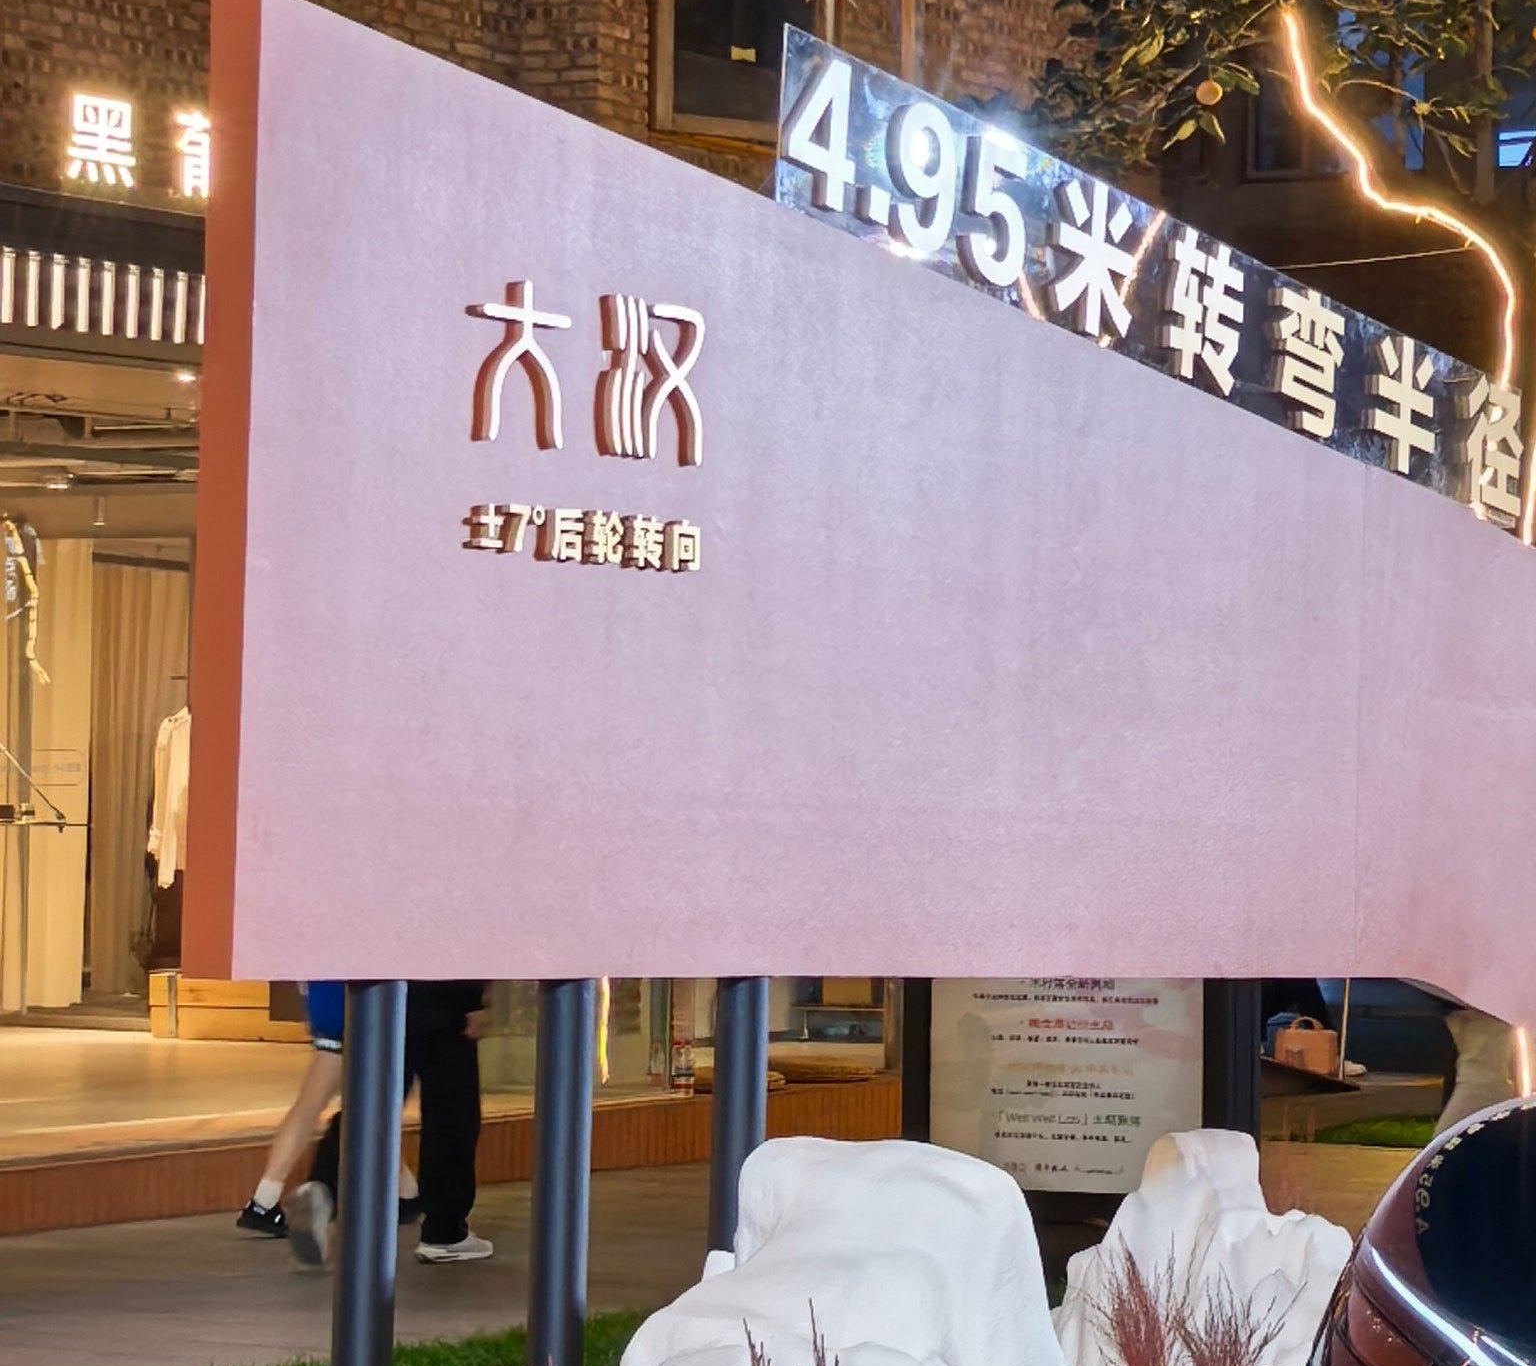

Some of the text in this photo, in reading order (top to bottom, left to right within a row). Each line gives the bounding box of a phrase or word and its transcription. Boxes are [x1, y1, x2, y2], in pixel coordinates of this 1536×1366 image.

[782, 55, 1524, 519] 4.95米转弯半径
